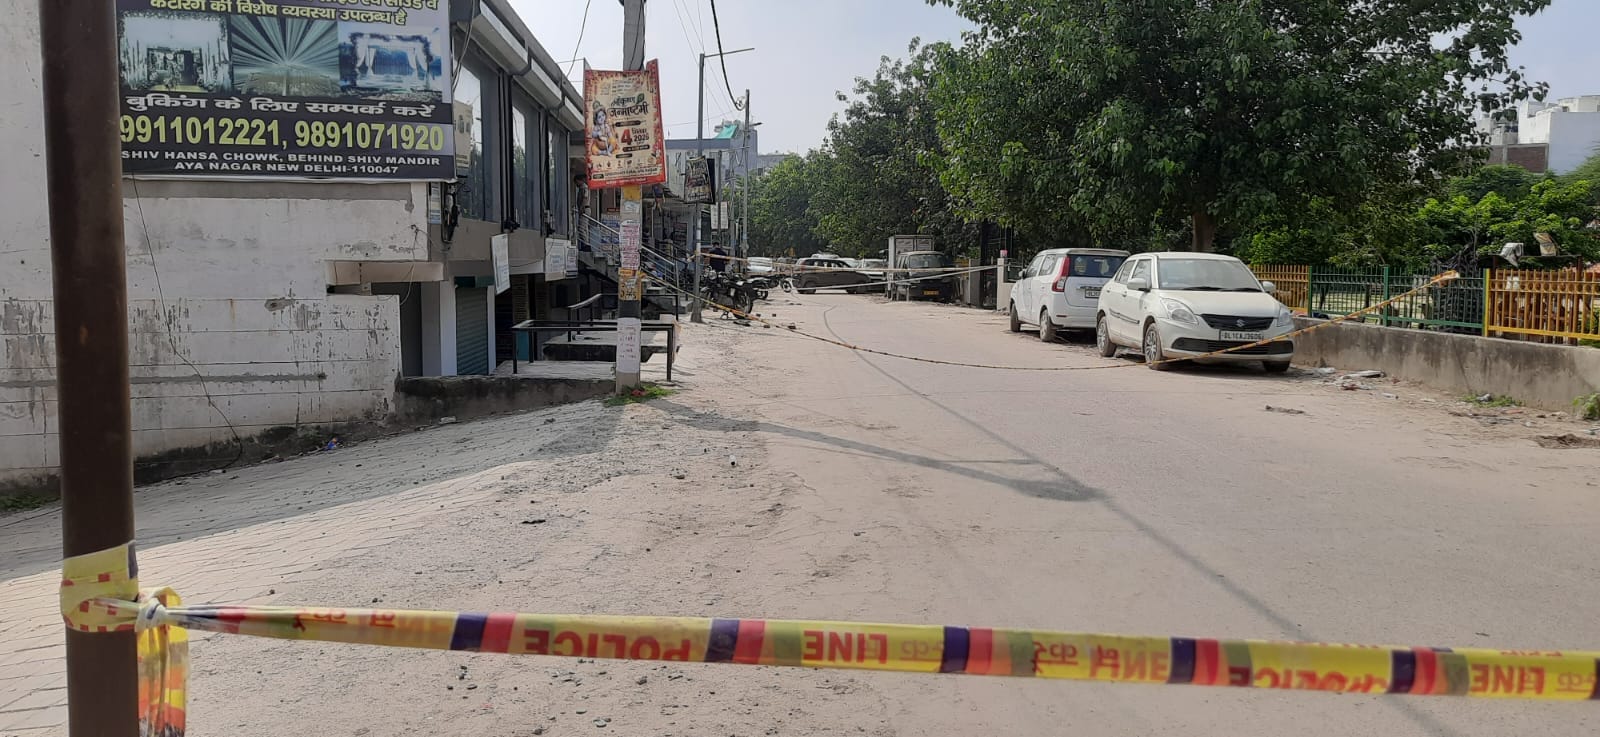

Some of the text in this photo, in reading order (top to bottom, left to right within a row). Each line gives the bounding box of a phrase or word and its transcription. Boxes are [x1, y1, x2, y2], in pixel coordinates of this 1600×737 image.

[236, 1, 277, 15] विशेष
[281, 4, 336, 19] व्यवस्था
[339, 10, 391, 23] उपलब्ध
[394, 9, 407, 25] है
[125, 93, 436, 117] बुकिंग के लिए सम्पर्क करें
[120, 114, 444, 150] 9911012221, 9891071920
[621, 128, 632, 145] 4
[121, 151, 440, 165] SHIV HANSA CHOWK, BEHIND SHIV MANDIR
[174, 162, 399, 174] AYA NAGAR NEW DELHI-110047
[524, 628, 691, 661] POLICE
[803, 630, 888, 664] LINE
[1471, 663, 1546, 695] LINE
